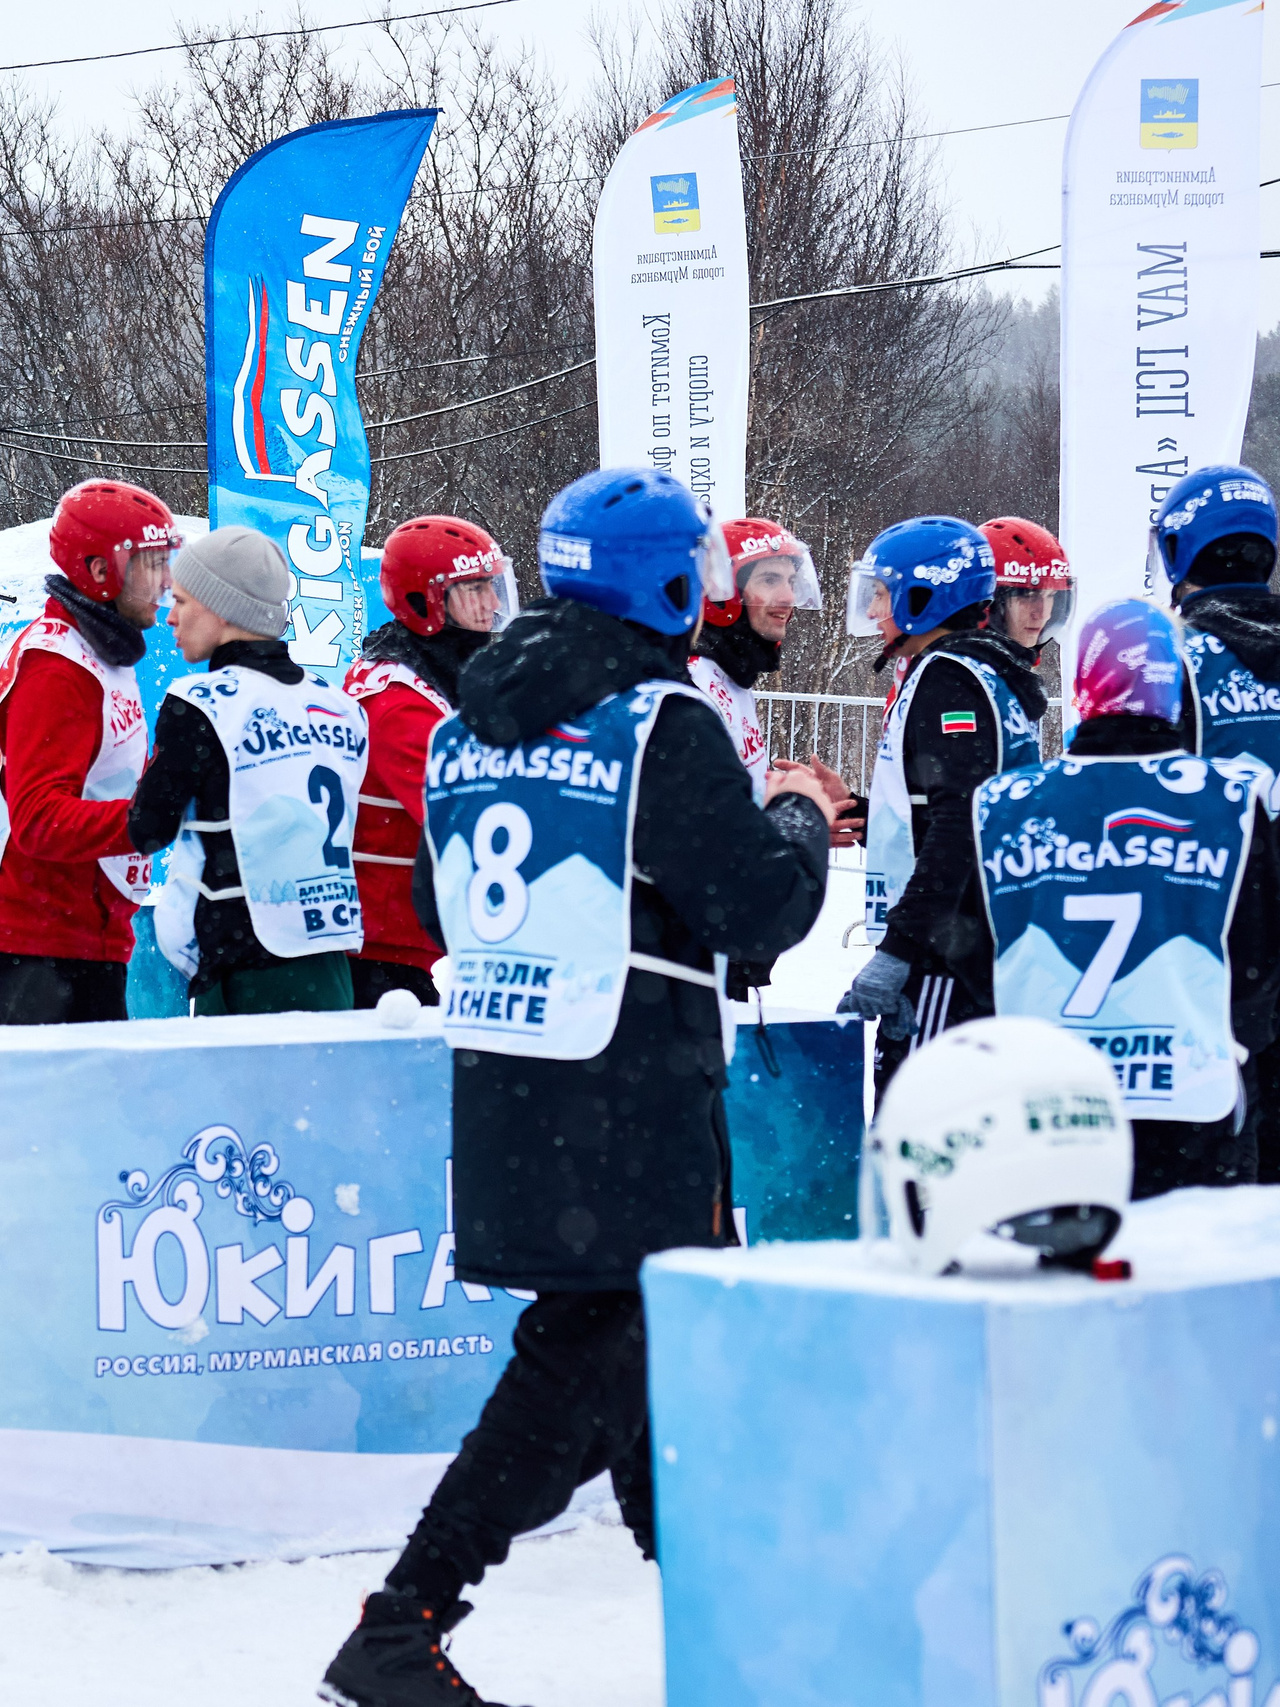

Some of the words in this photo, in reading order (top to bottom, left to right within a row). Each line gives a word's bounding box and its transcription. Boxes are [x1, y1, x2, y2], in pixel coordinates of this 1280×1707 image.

[338, 268, 374, 363] СНЕЖНЫЙ
[362, 225, 387, 264] БОЙ
[280, 213, 361, 668] KIGASSEN
[350, 595, 364, 663] MANSK
[1202, 682, 1280, 716] YUKIG
[308, 765, 350, 869] 2
[466, 802, 534, 944] 8
[984, 833, 1230, 883] YUKIGASSEN
[303, 908, 326, 932] В
[484, 962, 553, 988] ТОЛК
[1061, 892, 1142, 1018] 7
[460, 989, 547, 1024] СНЕГЕ
[96, 1352, 205, 1378] РОССИЯ,
[208, 1341, 382, 1373] МУРМАНСКАЯ
[387, 1334, 494, 1361] ОБЛАСТЬ
